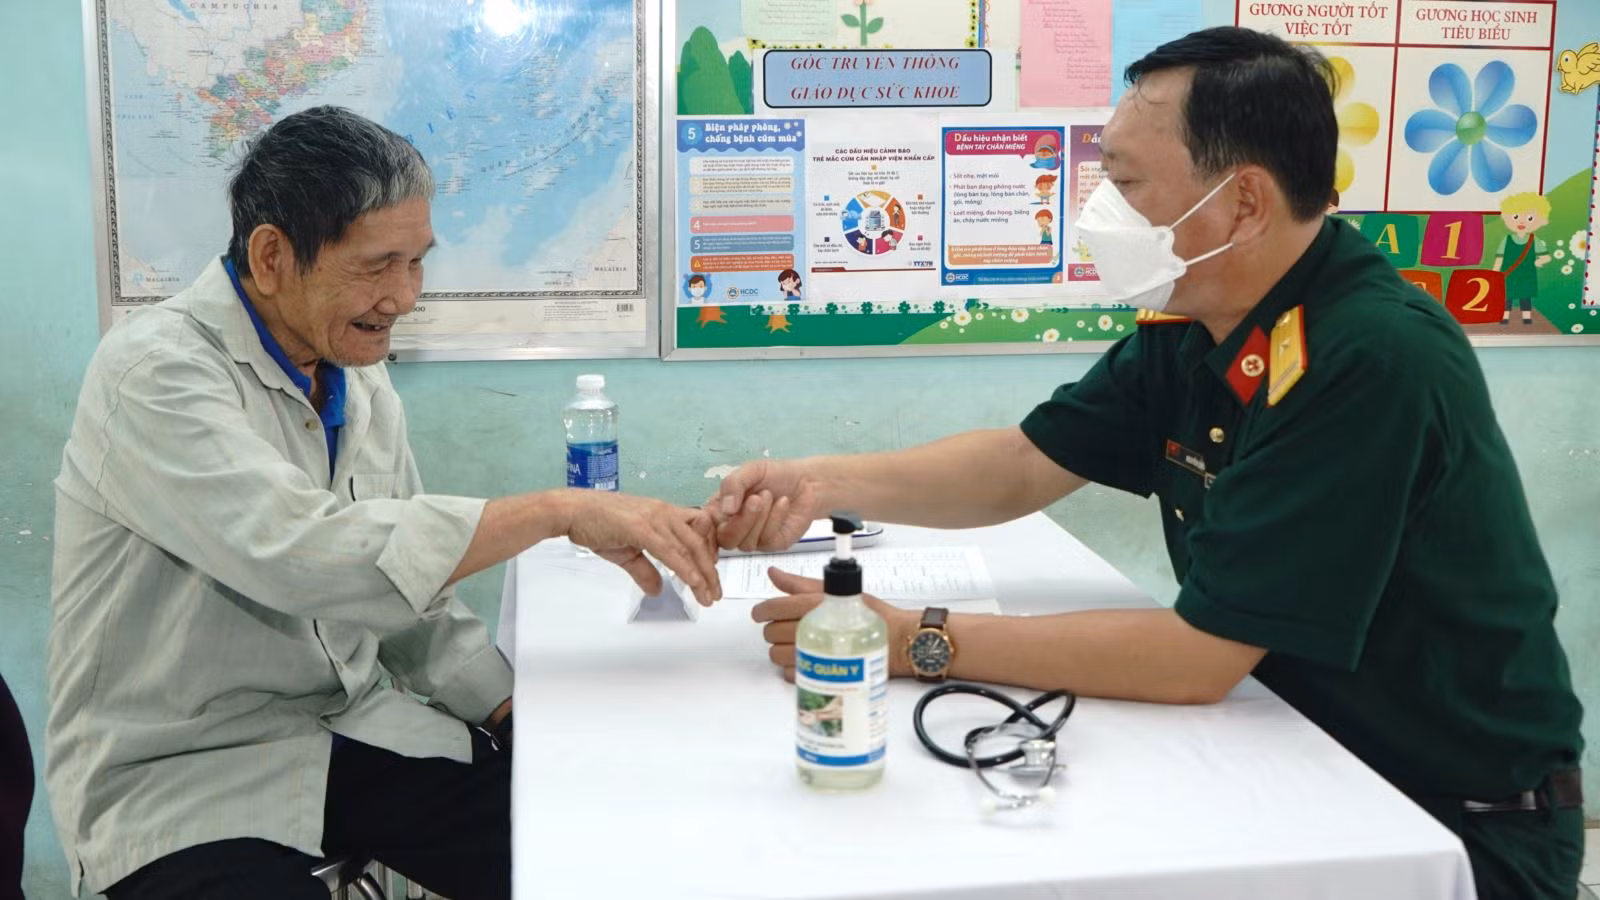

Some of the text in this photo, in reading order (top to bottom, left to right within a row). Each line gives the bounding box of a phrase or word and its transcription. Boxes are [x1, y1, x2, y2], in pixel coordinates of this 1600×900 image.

[1249, 1, 1388, 19] GƯƠNG NGƯỜI TỐT
[1416, 8, 1537, 25] GƯƠNG HỌC SINH
[1285, 18, 1352, 37] VIỆC TỐT
[1441, 23, 1511, 40] TIÊU BIỂU
[687, 127, 696, 140] 5
[705, 122, 725, 133] Biện
[728, 122, 749, 133] pháp
[705, 133, 731, 144] chống
[733, 134, 755, 144] bệnh
[954, 132, 972, 142] Dấu
[973, 132, 991, 143] hiệu
[991, 132, 1011, 143] nhận
[693, 219, 701, 231] 4
[693, 239, 701, 250] 5
[1375, 223, 1401, 255] A
[1440, 220, 1464, 260] 1
[1461, 277, 1491, 312] 2
